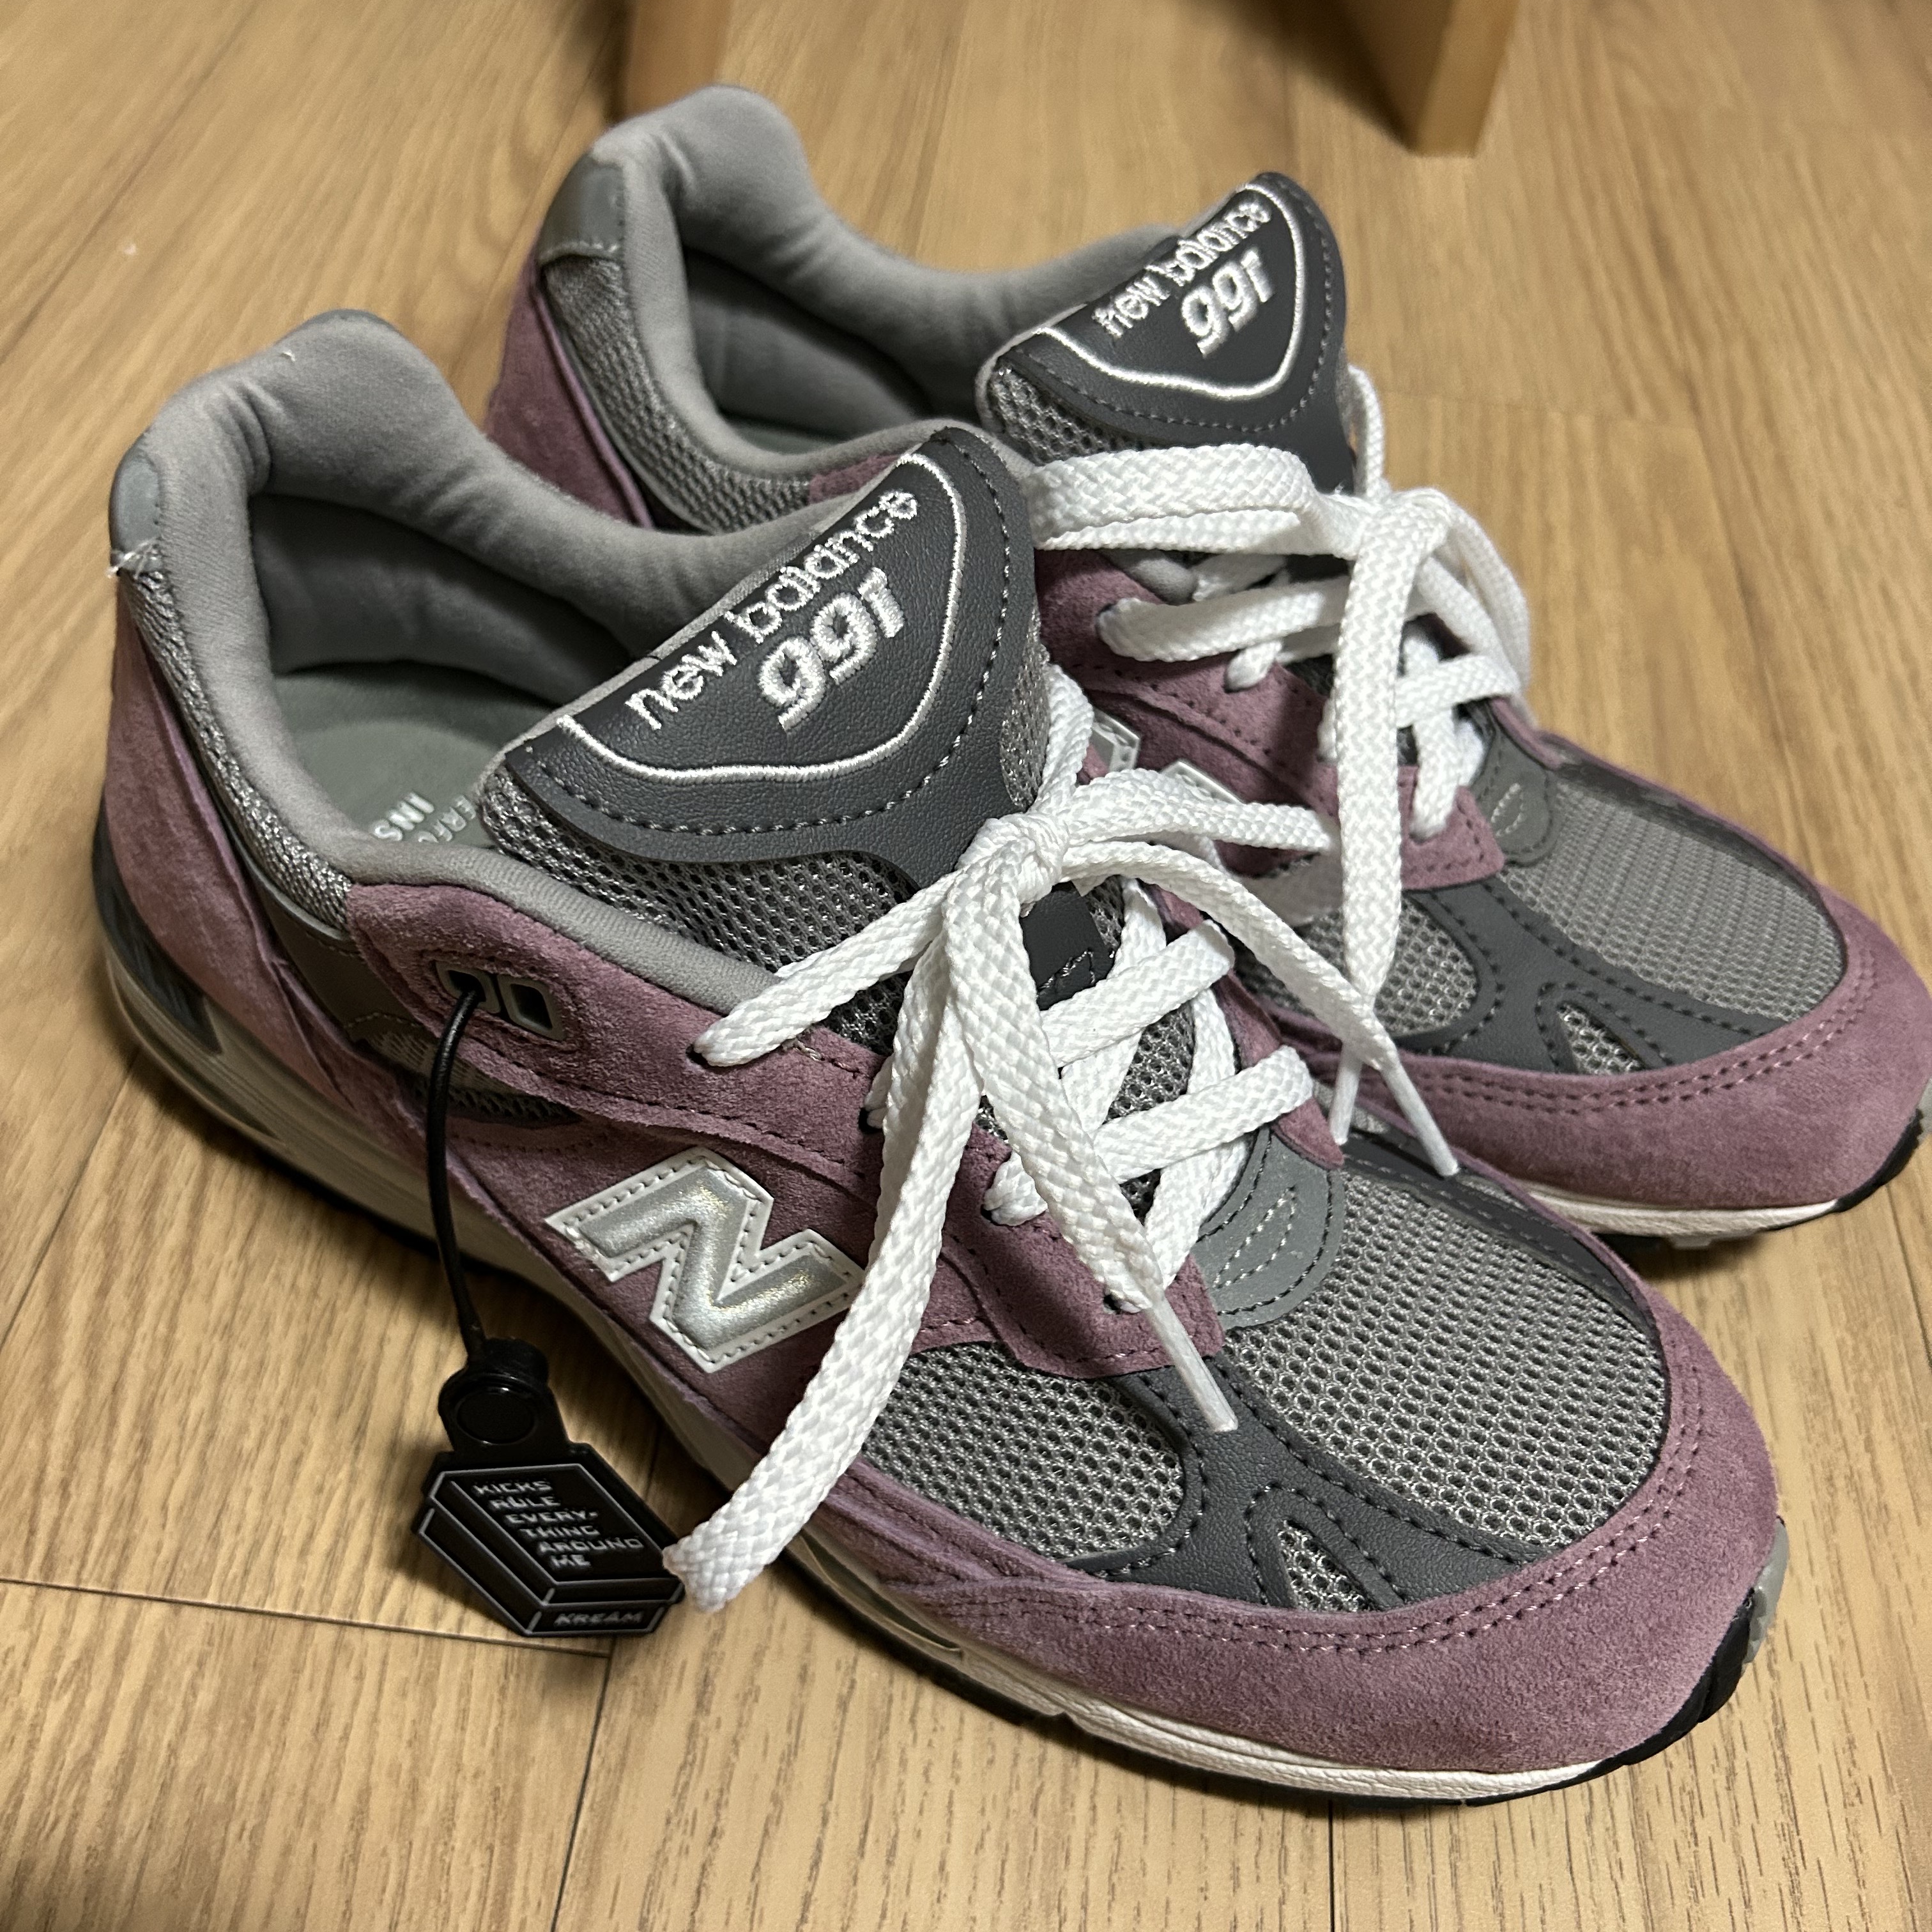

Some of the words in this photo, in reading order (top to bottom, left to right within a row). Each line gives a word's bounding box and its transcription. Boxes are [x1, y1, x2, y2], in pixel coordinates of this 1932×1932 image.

[1091, 274, 1172, 339] new
[1144, 202, 1272, 288] balance
[1181, 247, 1275, 359] 991
[625, 631, 737, 730] new
[724, 490, 918, 644] balance
[758, 567, 905, 732] 991
[472, 1479, 553, 1498] KICKS
[488, 1495, 561, 1512] RULE
[519, 1524, 601, 1540] THING
[538, 1537, 645, 1555] AROUND
[550, 1553, 592, 1569] ME
[553, 1611, 643, 1627] KREAM
